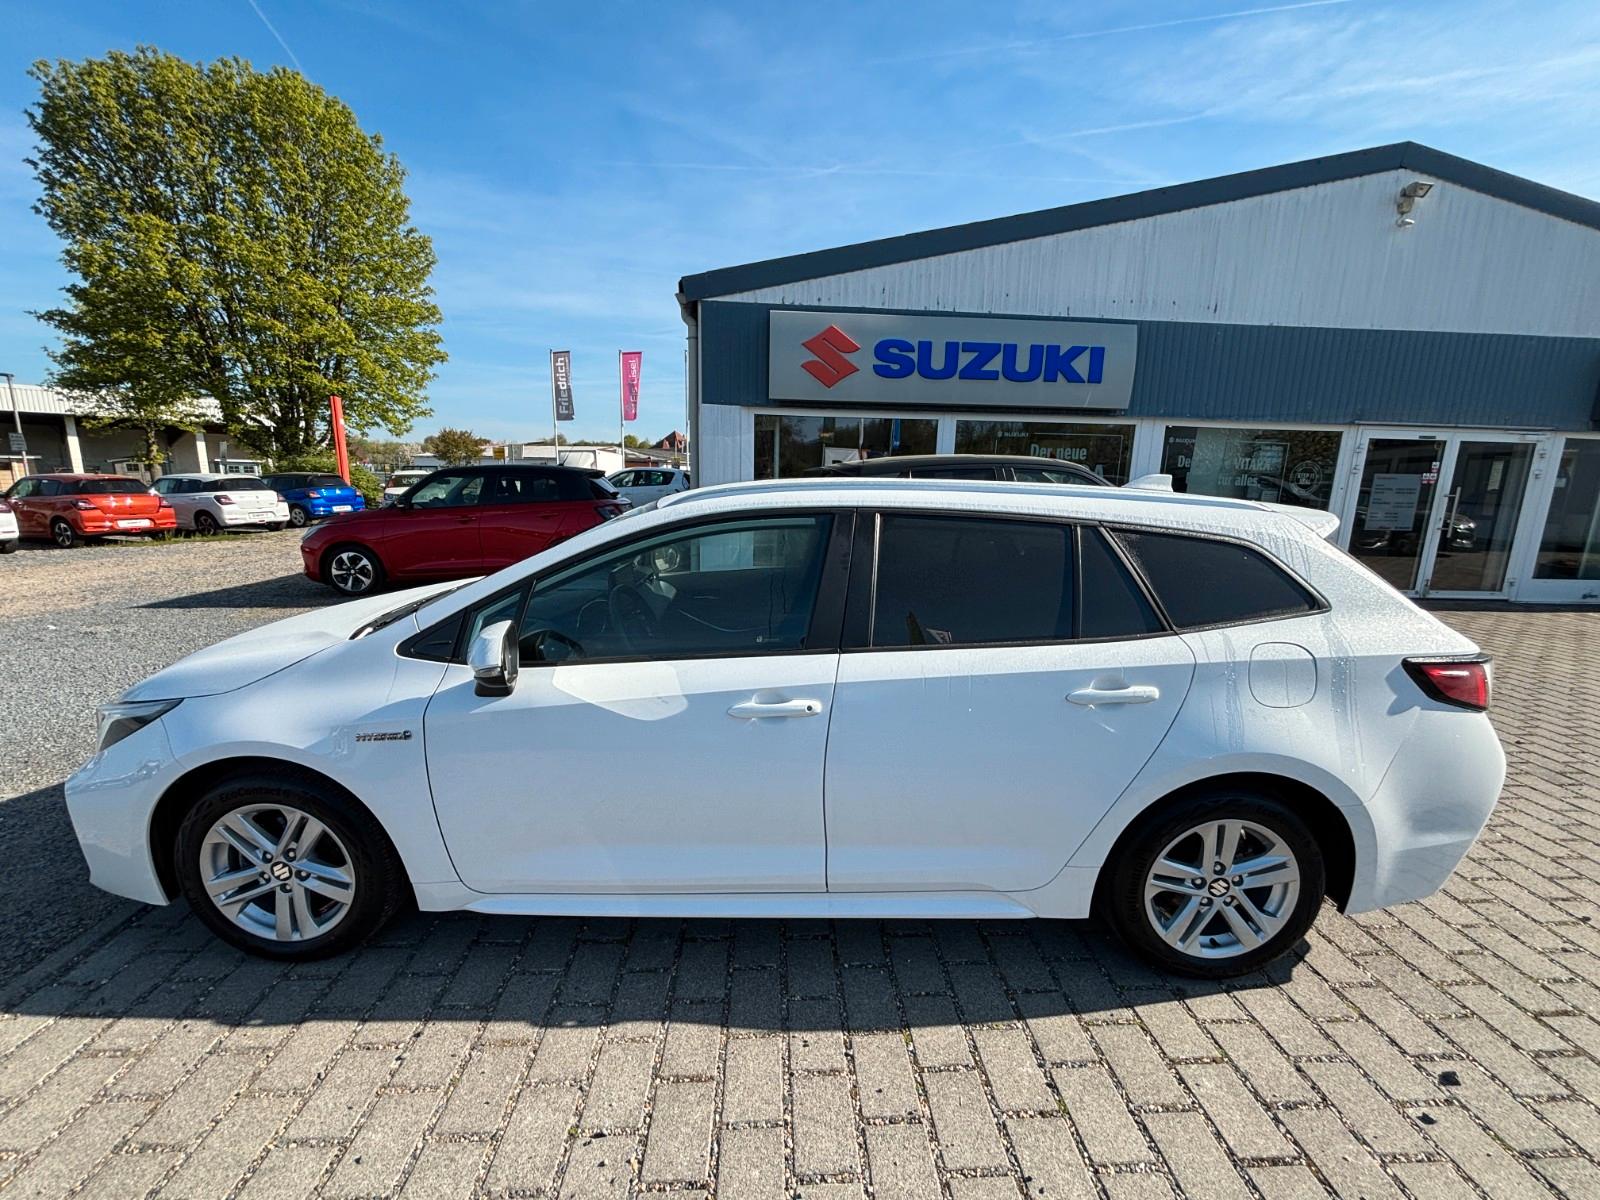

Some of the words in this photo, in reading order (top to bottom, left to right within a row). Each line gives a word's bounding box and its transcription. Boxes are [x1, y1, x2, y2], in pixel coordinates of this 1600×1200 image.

[872, 338, 1106, 385] SUZUKI
[556, 357, 570, 414] Friedrich
[1030, 443, 1052, 459] Der
[1055, 446, 1088, 460] neue
